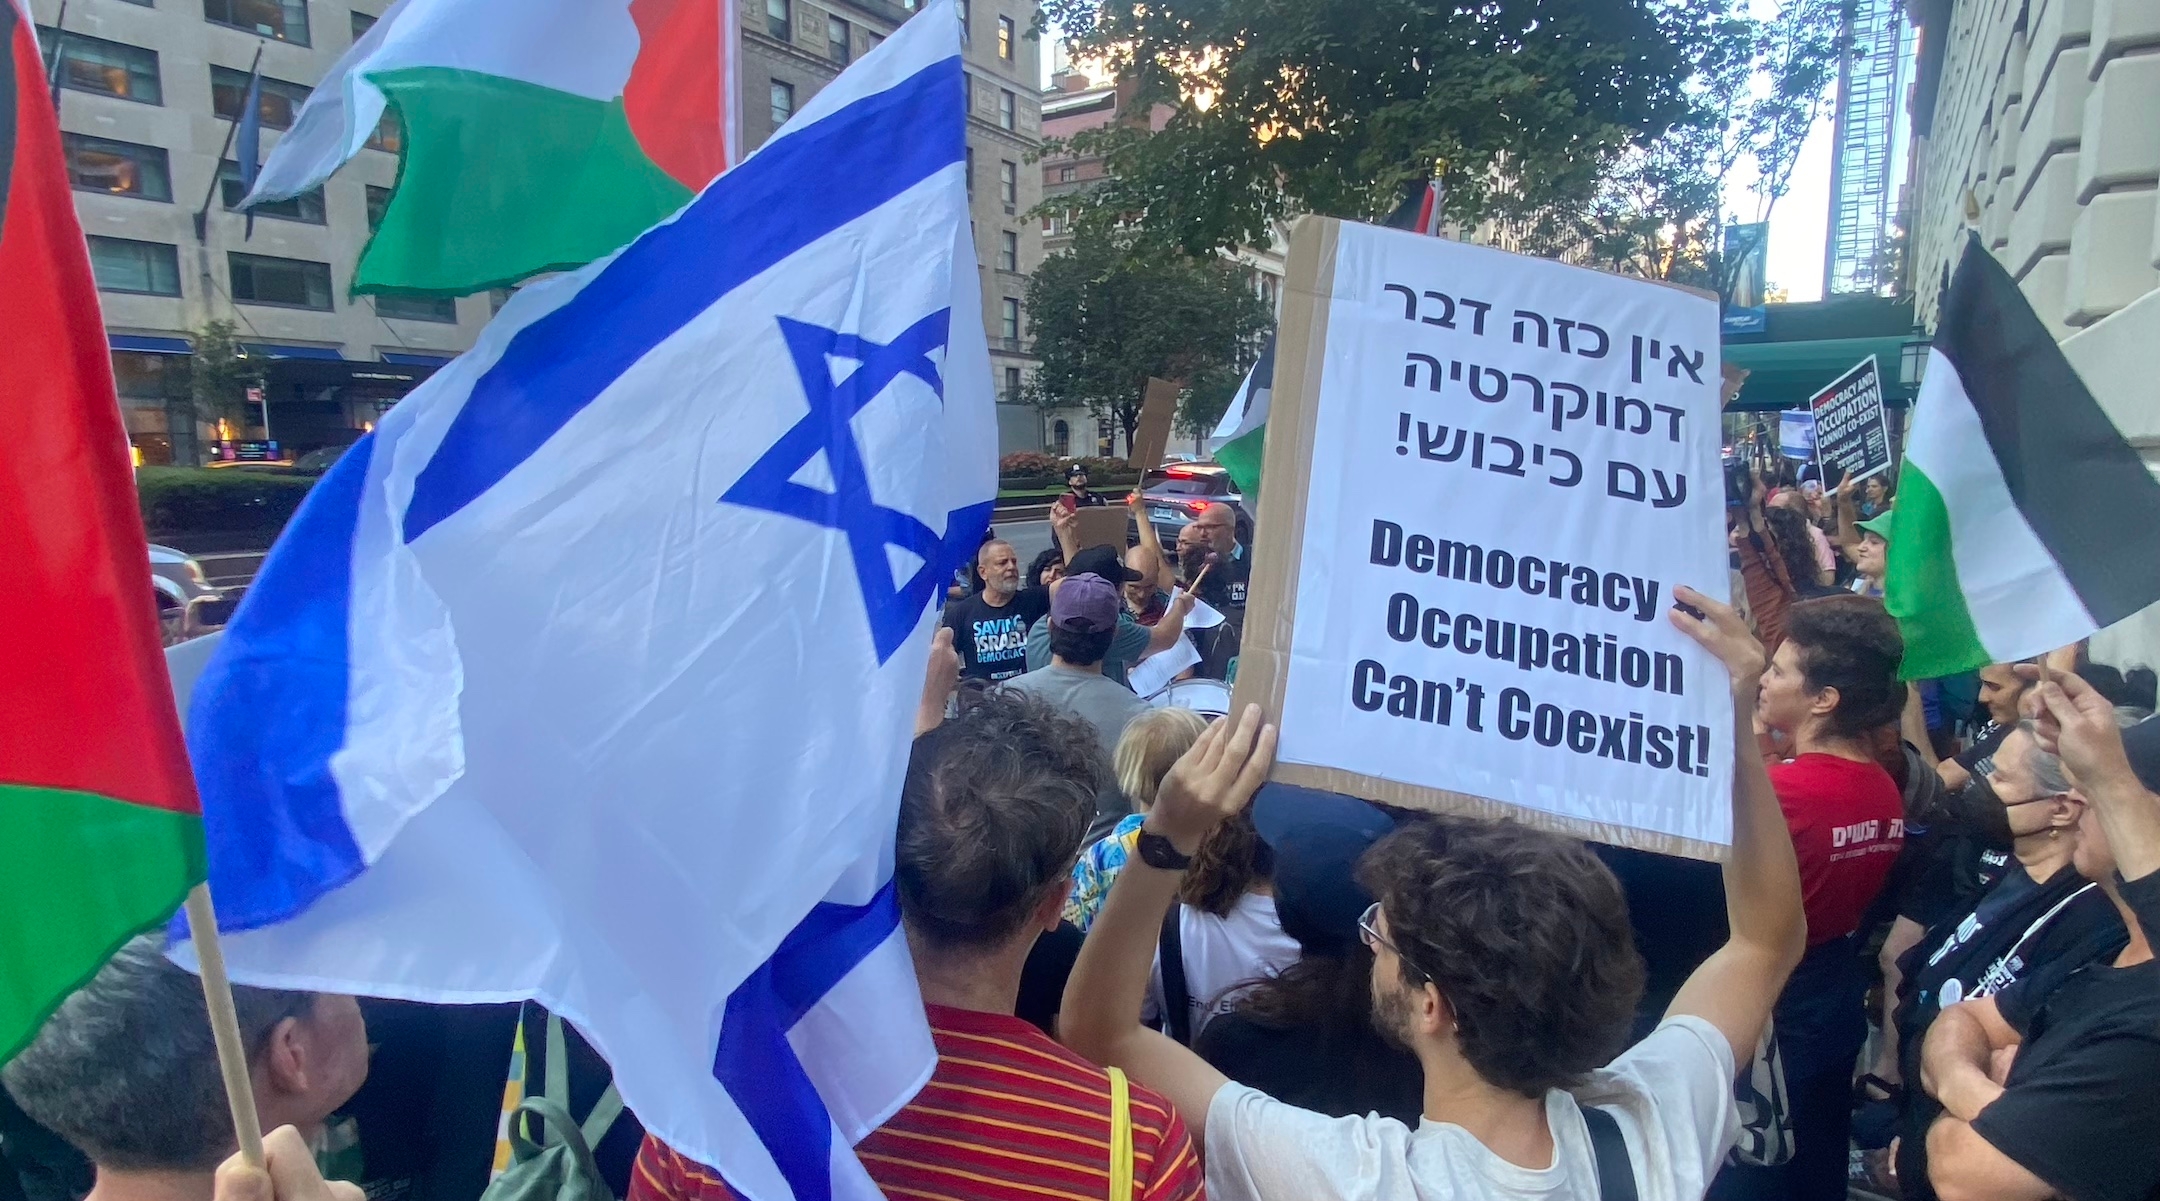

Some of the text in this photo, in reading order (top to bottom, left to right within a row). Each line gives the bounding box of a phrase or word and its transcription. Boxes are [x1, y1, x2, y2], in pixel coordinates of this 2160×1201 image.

[1384, 283, 1705, 385] אין כזה דבר
[1404, 352, 1686, 442] דמוקרטיה
[1814, 371, 1875, 420] DEMOCRACY AND
[1817, 386, 1877, 436] OCCUPATION
[1820, 423, 1847, 449] CANNOT
[1847, 404, 1879, 433] CO-EXIST
[1395, 412, 1687, 509] עם כיבוש!
[1369, 518, 1660, 623] Democracy
[976, 646, 1027, 664] DEMOCRAC
[1386, 592, 1684, 696] Occupation
[1351, 658, 1711, 778] Can't Coexist!
